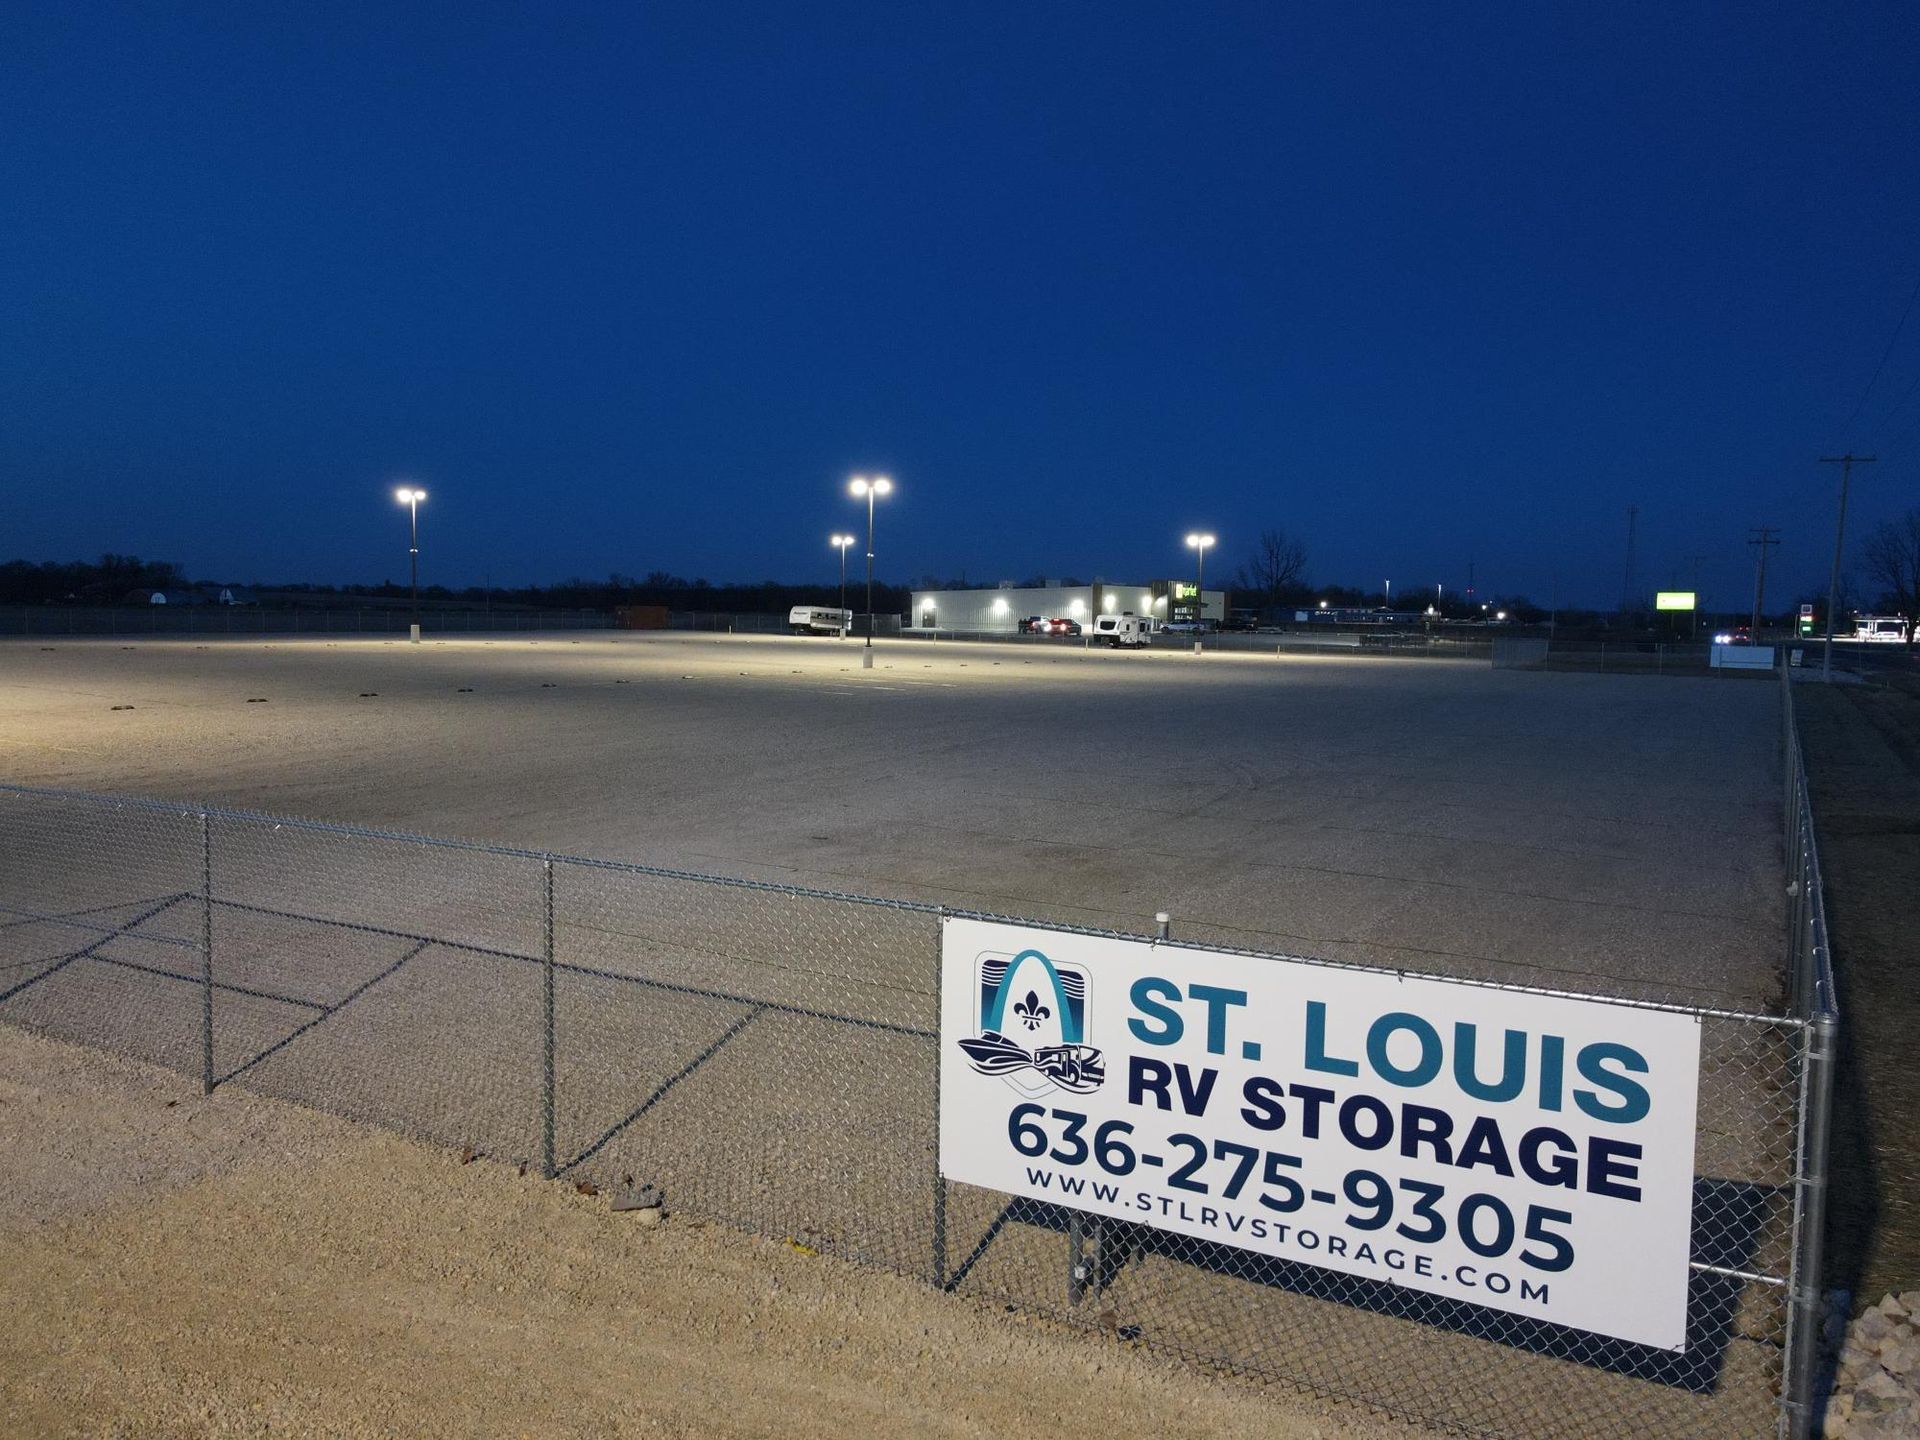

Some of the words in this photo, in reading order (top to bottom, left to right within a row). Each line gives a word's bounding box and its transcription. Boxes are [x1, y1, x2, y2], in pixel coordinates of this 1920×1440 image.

[1128, 976, 1262, 1062] ST.
[1304, 1000, 1651, 1125] LOUIS
[1007, 1102, 1579, 1273] 636-275-9305
[1127, 1056, 1219, 1118] RV
[1239, 1076, 1643, 1203] STORAGE
[1026, 1166, 1549, 1305] WWW.STLRVSTORAGE.COM
